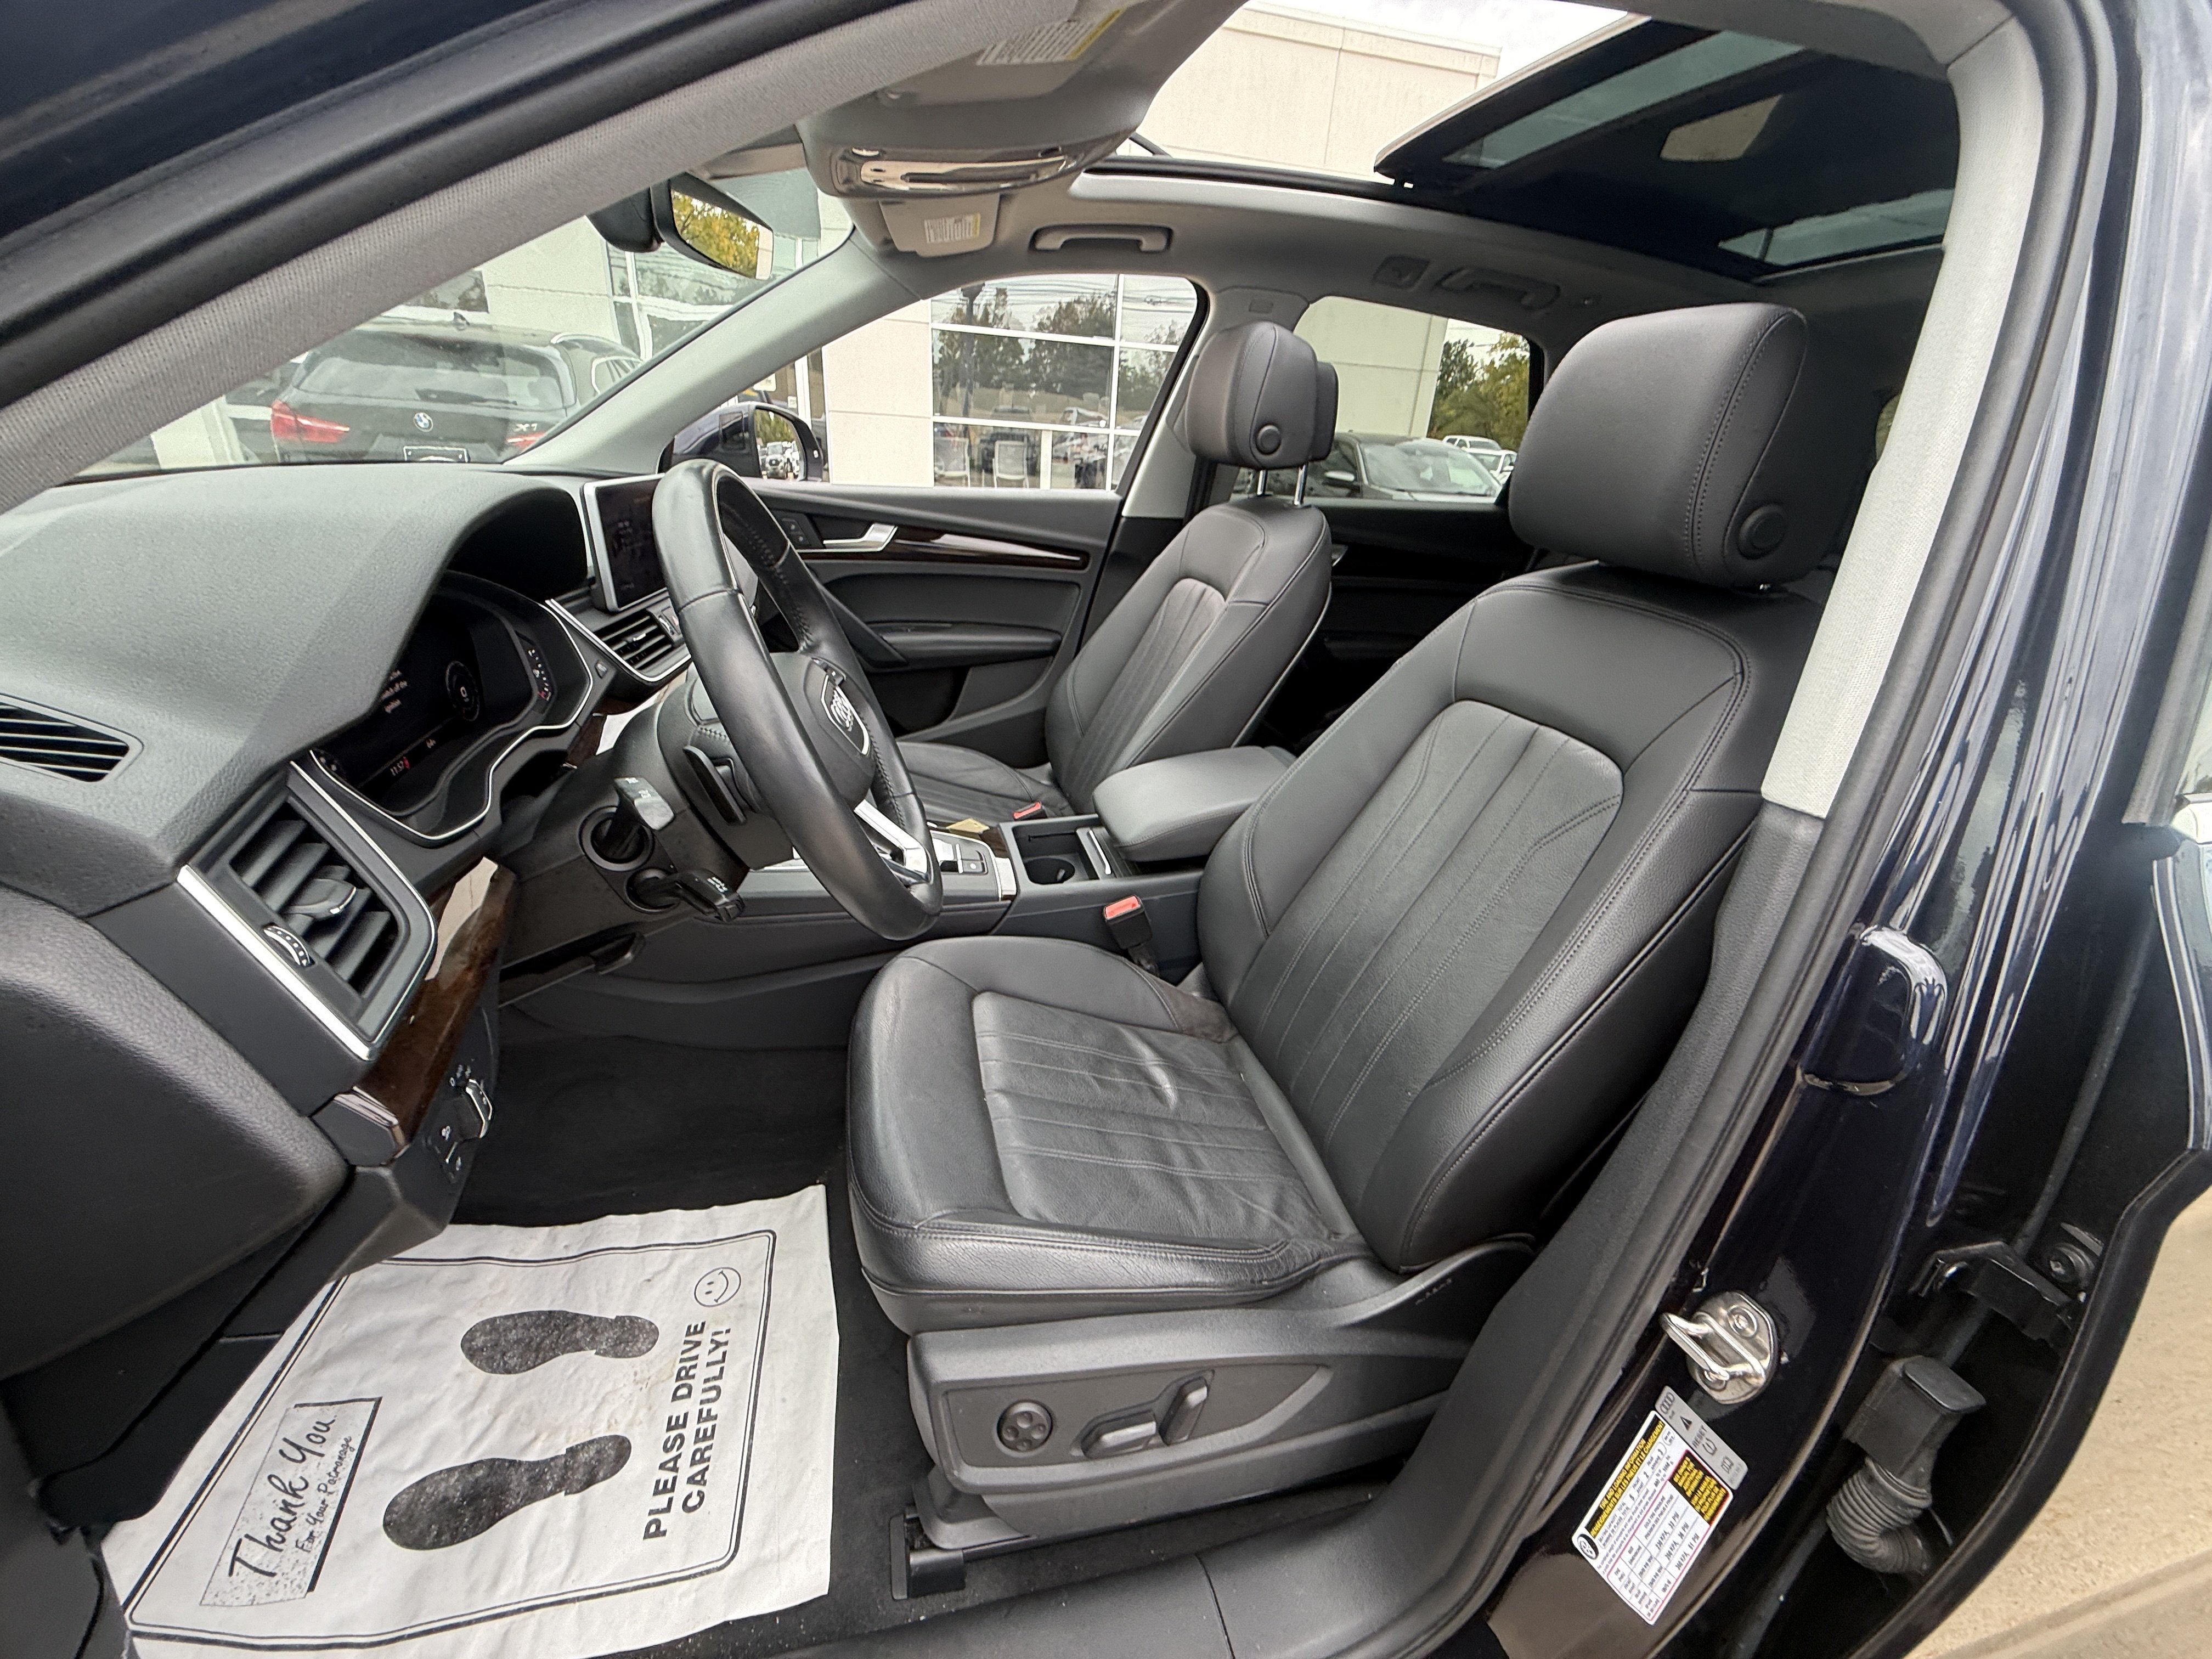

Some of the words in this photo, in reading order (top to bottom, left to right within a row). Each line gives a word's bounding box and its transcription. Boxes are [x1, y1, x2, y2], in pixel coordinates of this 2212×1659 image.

[643, 1411, 689, 1541] PLEASE
[670, 1321, 706, 1403] DRIVE
[682, 1328, 731, 1514] CAREFULLY!
[1611, 1468, 1627, 1491] LOADING
[1691, 1425, 1707, 1448] RESET
[228, 1474, 309, 1577] Thank
[278, 1419, 336, 1464] You
[295, 1530, 315, 1553] For
[305, 1498, 329, 1526] Your
[317, 1436, 356, 1496] Patronage
